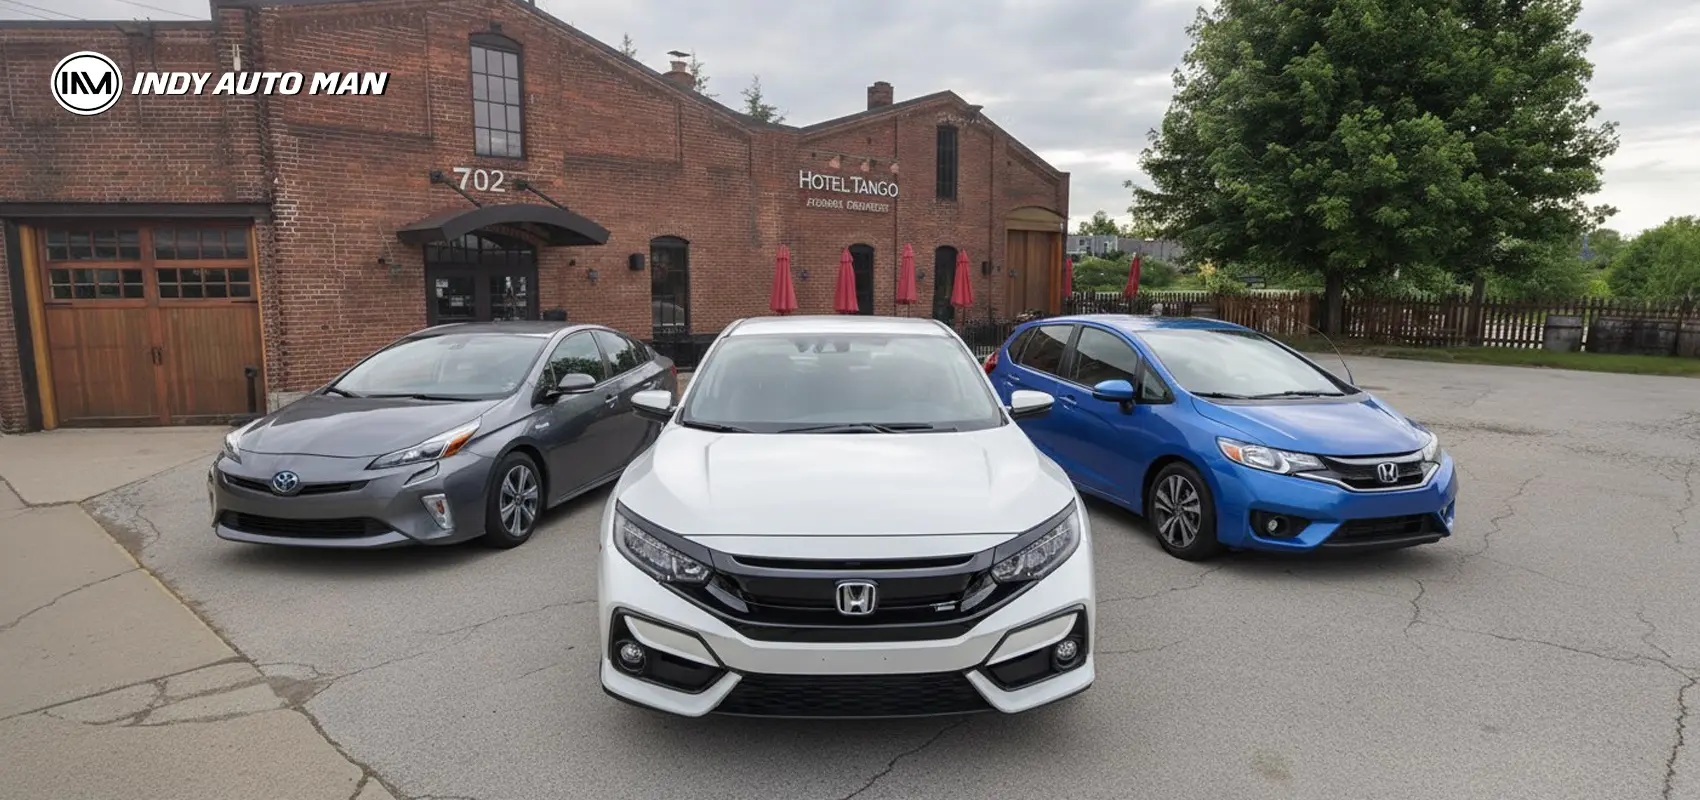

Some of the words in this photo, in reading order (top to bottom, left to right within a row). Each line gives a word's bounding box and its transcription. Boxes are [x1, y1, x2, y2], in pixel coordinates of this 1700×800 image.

[453, 167, 506, 192] 702
[799, 169, 850, 193] HOTEL
[850, 175, 899, 198] TANGO
